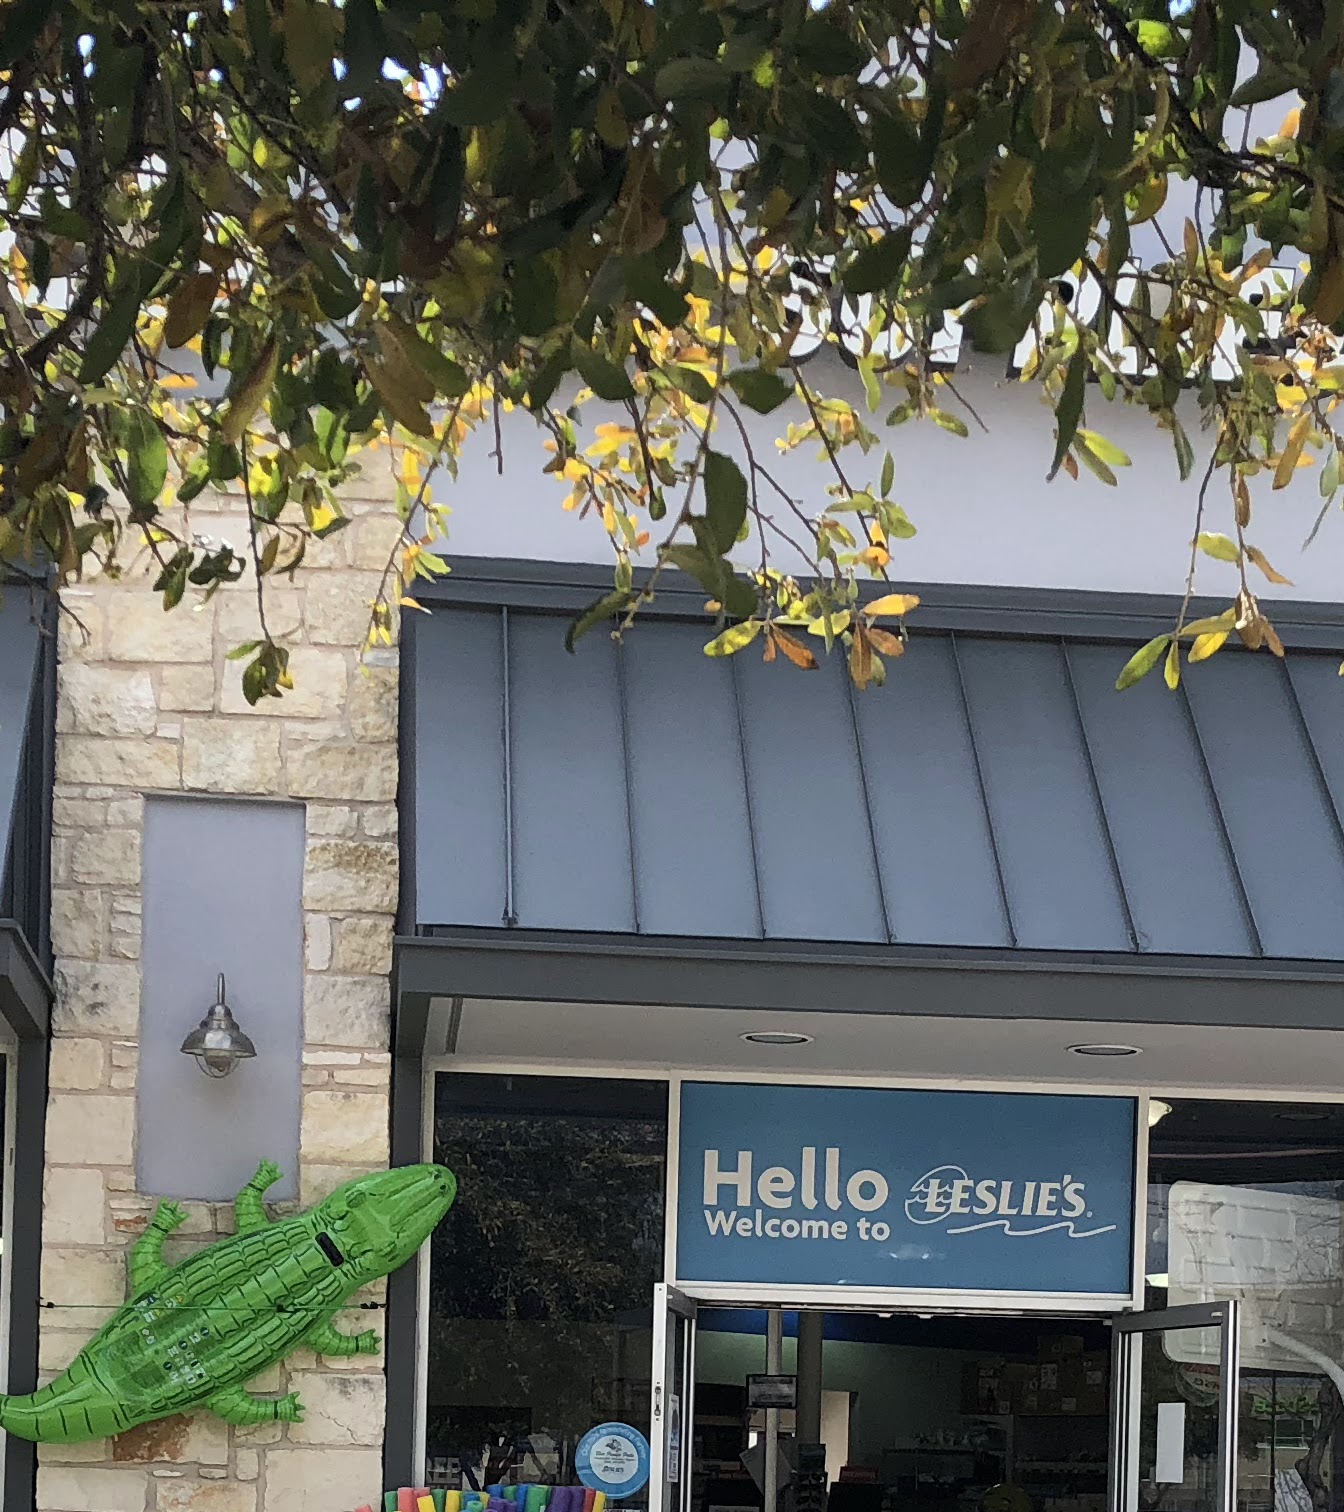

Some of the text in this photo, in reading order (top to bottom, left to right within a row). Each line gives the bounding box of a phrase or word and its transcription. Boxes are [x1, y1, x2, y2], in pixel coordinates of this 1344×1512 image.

[703, 1146, 1085, 1218] Hello LESLIE'S
[703, 1208, 891, 1241] Welcome to
